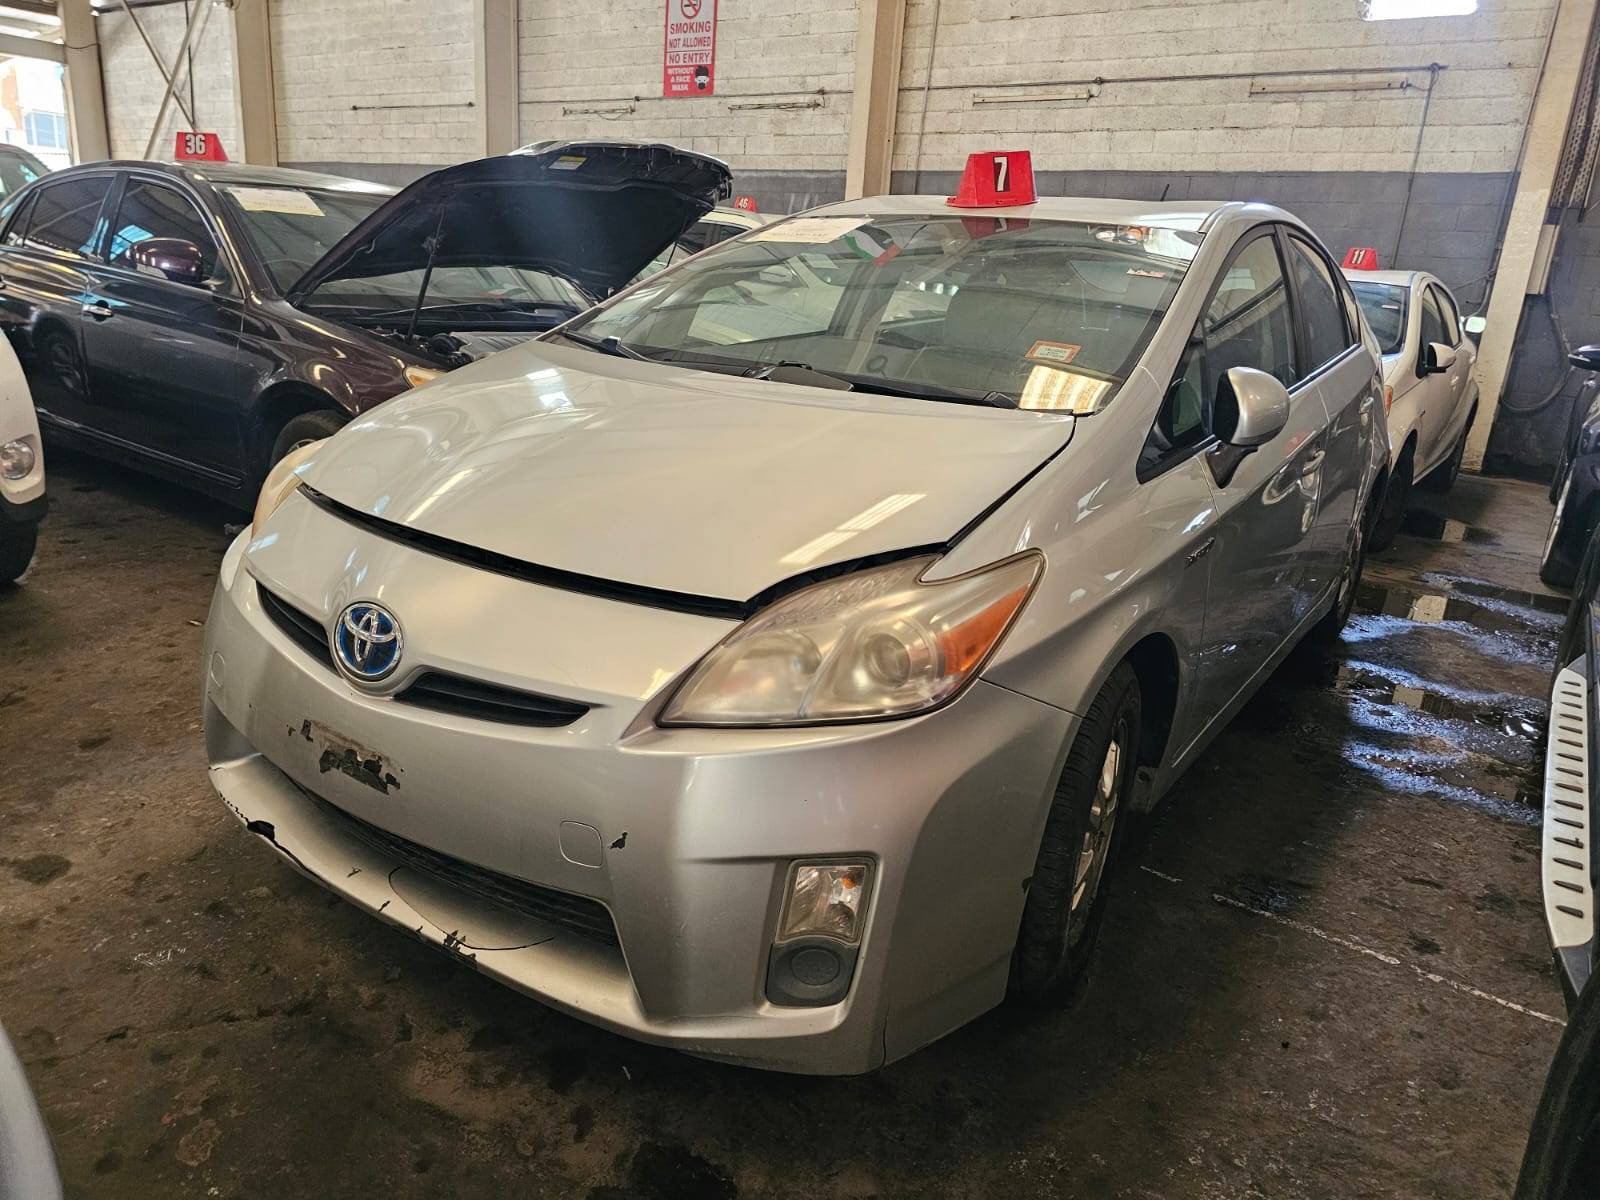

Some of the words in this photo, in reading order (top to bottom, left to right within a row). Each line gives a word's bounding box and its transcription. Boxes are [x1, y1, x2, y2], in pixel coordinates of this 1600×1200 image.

[670, 21, 711, 34] SMOKING
[669, 38, 681, 48] NOT
[682, 37, 711, 48] ALLOWED
[669, 54, 680, 64] NO
[683, 53, 710, 63] ENTRY
[185, 134, 206, 155] 36
[993, 156, 1008, 192] 7
[1351, 249, 1366, 264] 11
